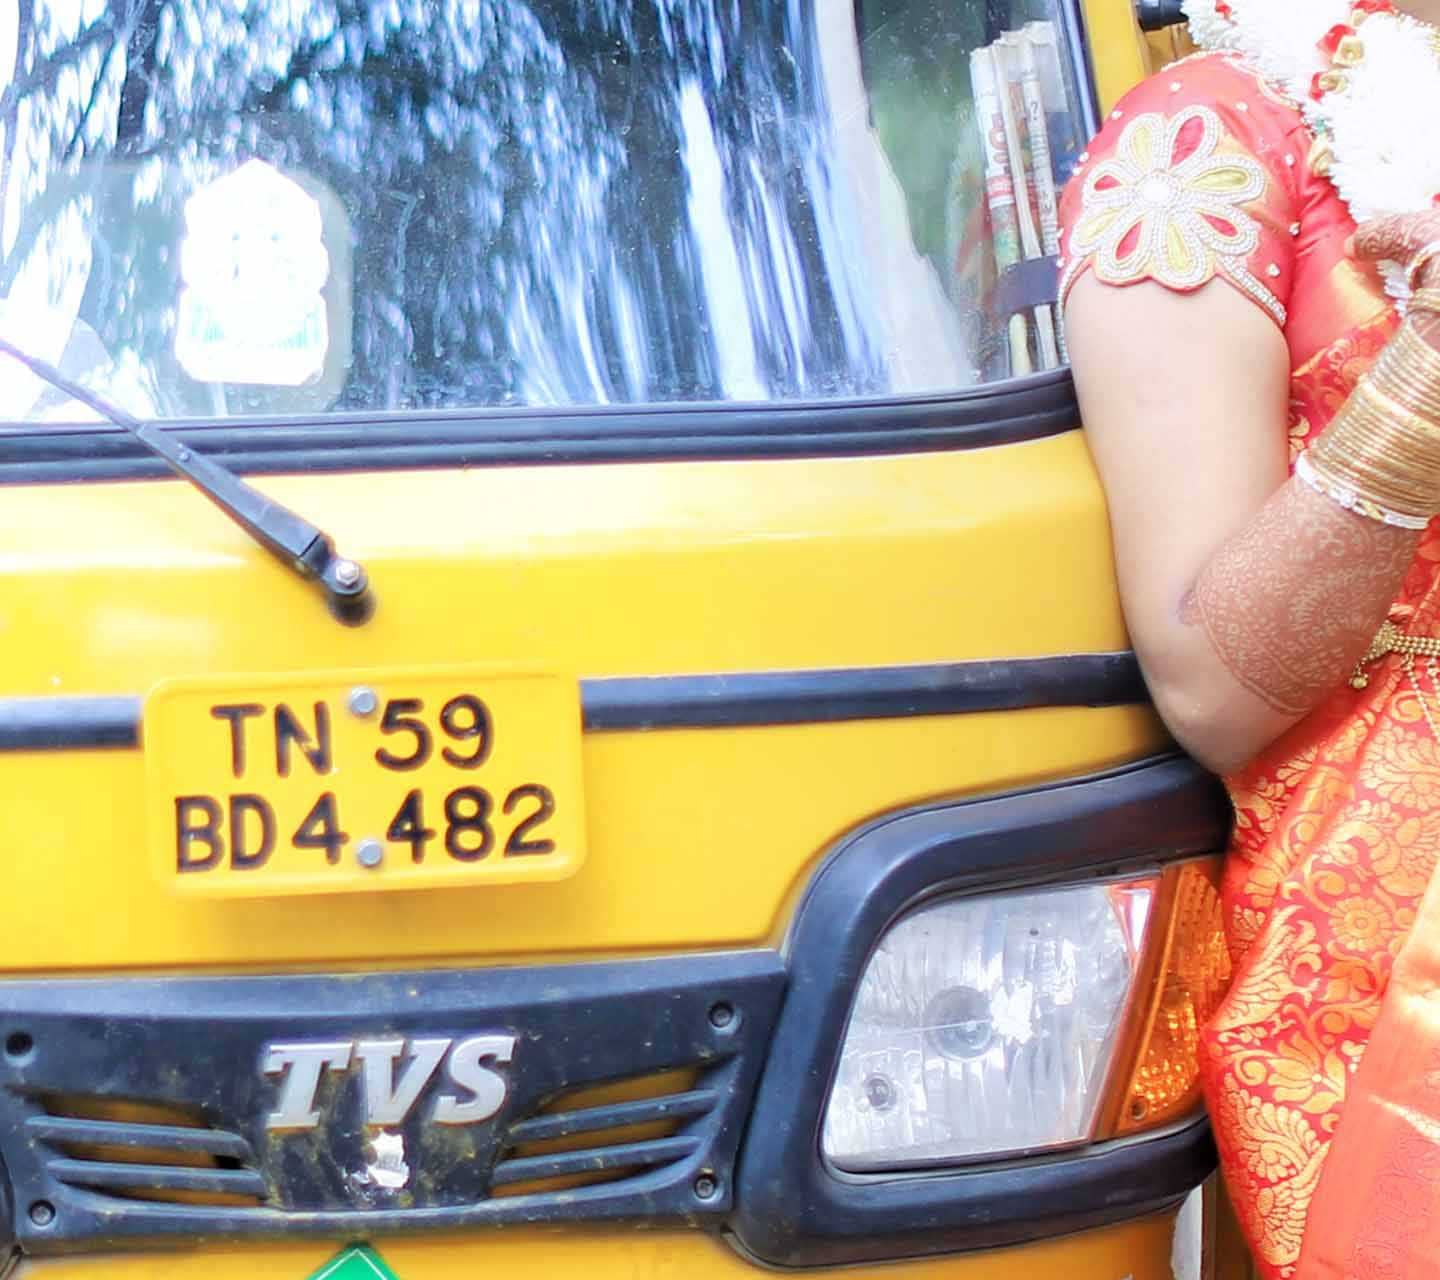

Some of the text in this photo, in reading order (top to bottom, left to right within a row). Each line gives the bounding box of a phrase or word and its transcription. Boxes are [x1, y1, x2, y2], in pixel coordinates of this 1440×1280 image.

[210, 694, 495, 778] TN 59
[260, 1035, 516, 1130] TVS
